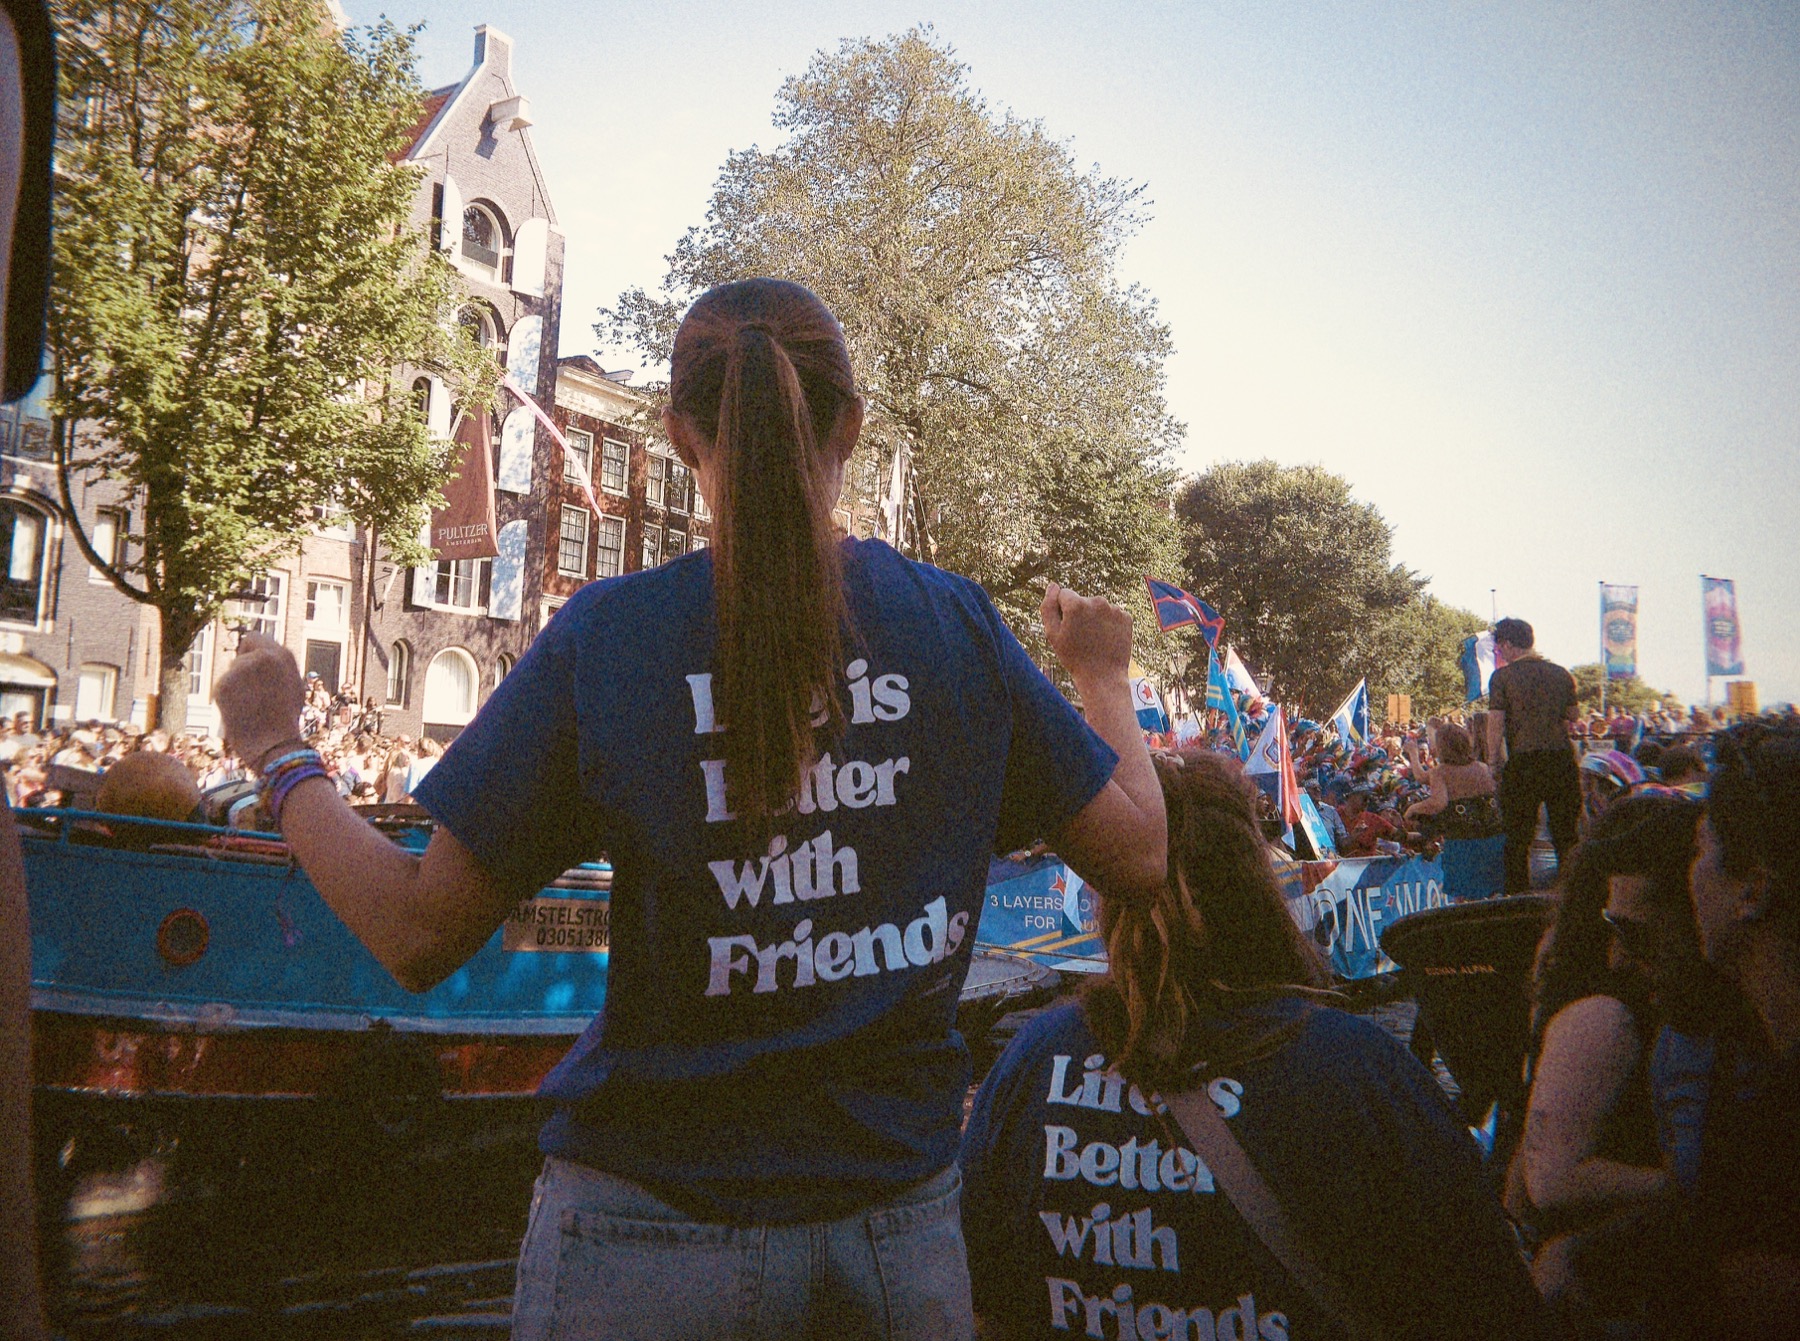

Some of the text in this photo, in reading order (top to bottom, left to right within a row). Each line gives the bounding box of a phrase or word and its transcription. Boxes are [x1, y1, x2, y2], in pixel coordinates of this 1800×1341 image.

[438, 523, 488, 540] PULITZER
[445, 537, 482, 546] AMSTERDAM
[846, 658, 911, 724] is
[707, 830, 861, 910] with
[990, 895, 999, 907] 3
[1003, 895, 1063, 911] LAYERS
[1024, 915, 1056, 930] FOR
[704, 895, 970, 996] Friends
[1043, 1125, 1216, 1194] Better
[1039, 1202, 1180, 1272] with
[1045, 1276, 1291, 1341] Friends
